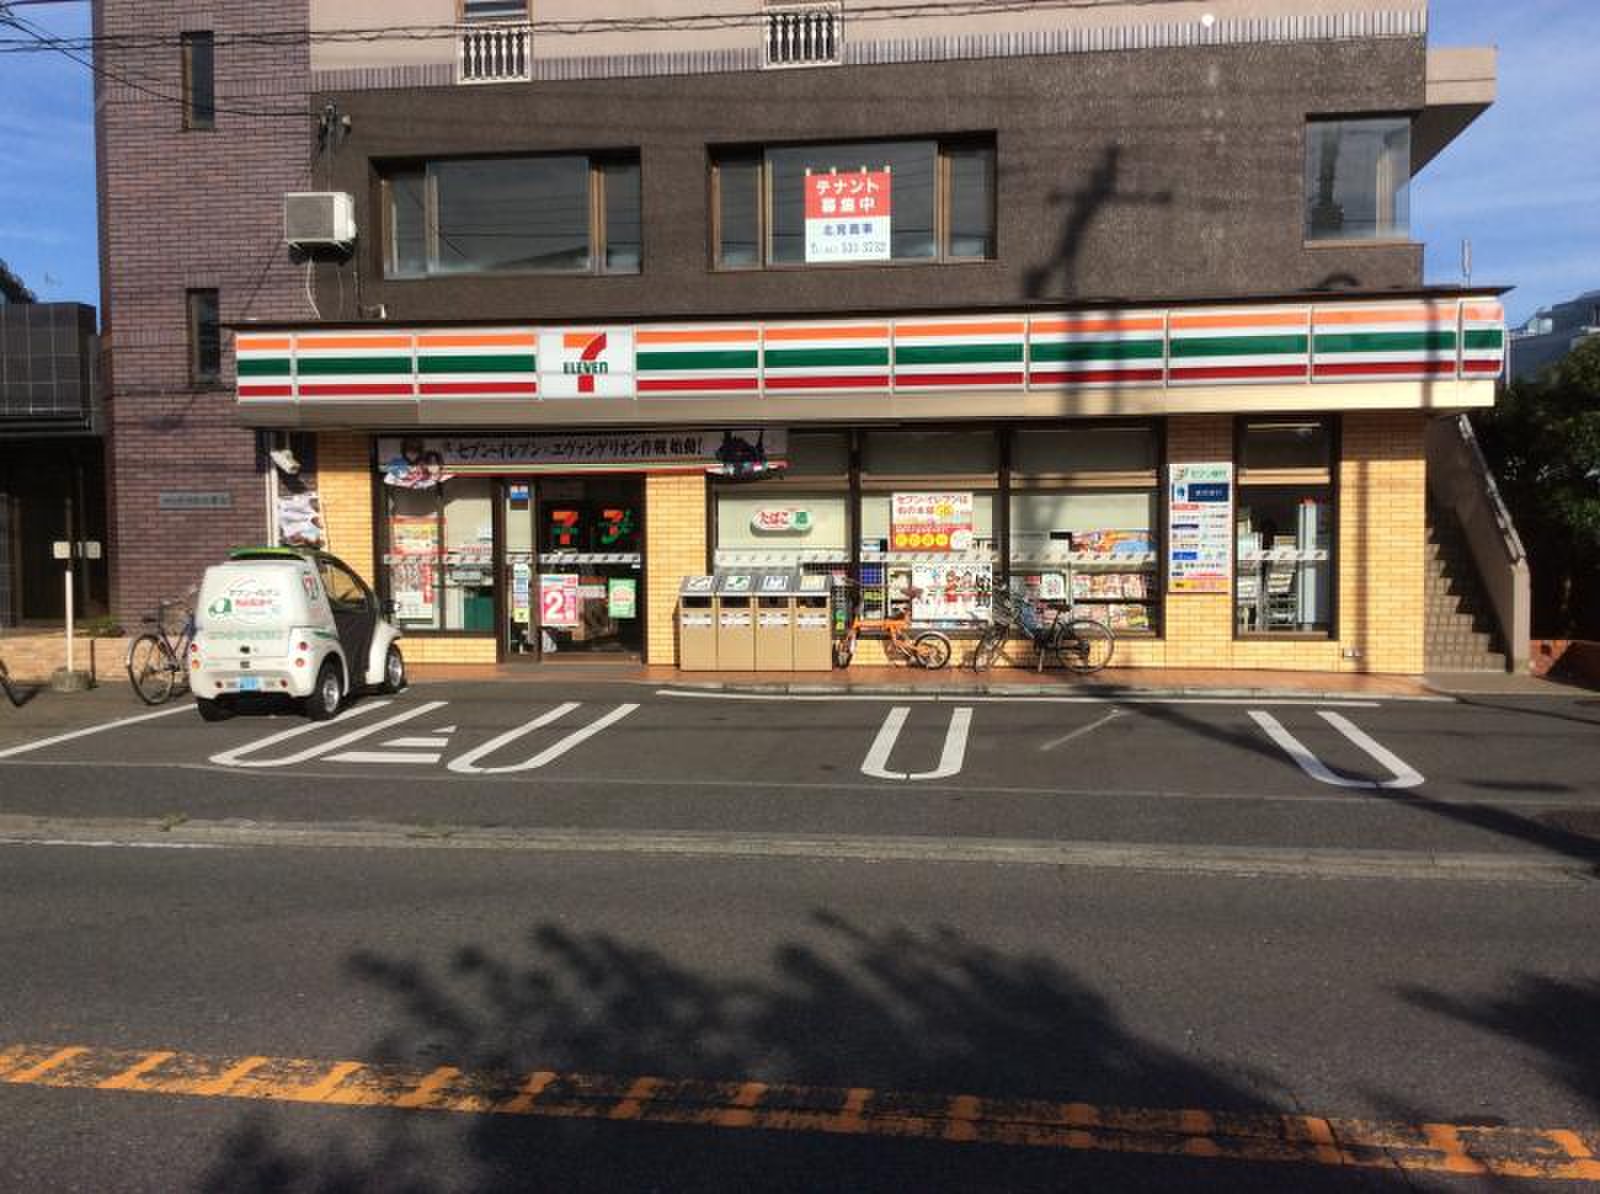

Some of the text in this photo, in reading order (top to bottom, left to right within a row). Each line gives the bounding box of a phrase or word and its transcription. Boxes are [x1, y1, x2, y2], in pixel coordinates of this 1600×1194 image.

[815, 176, 880, 195] テナント
[820, 195, 877, 214] 募集中
[760, 509, 790, 526] たばこ
